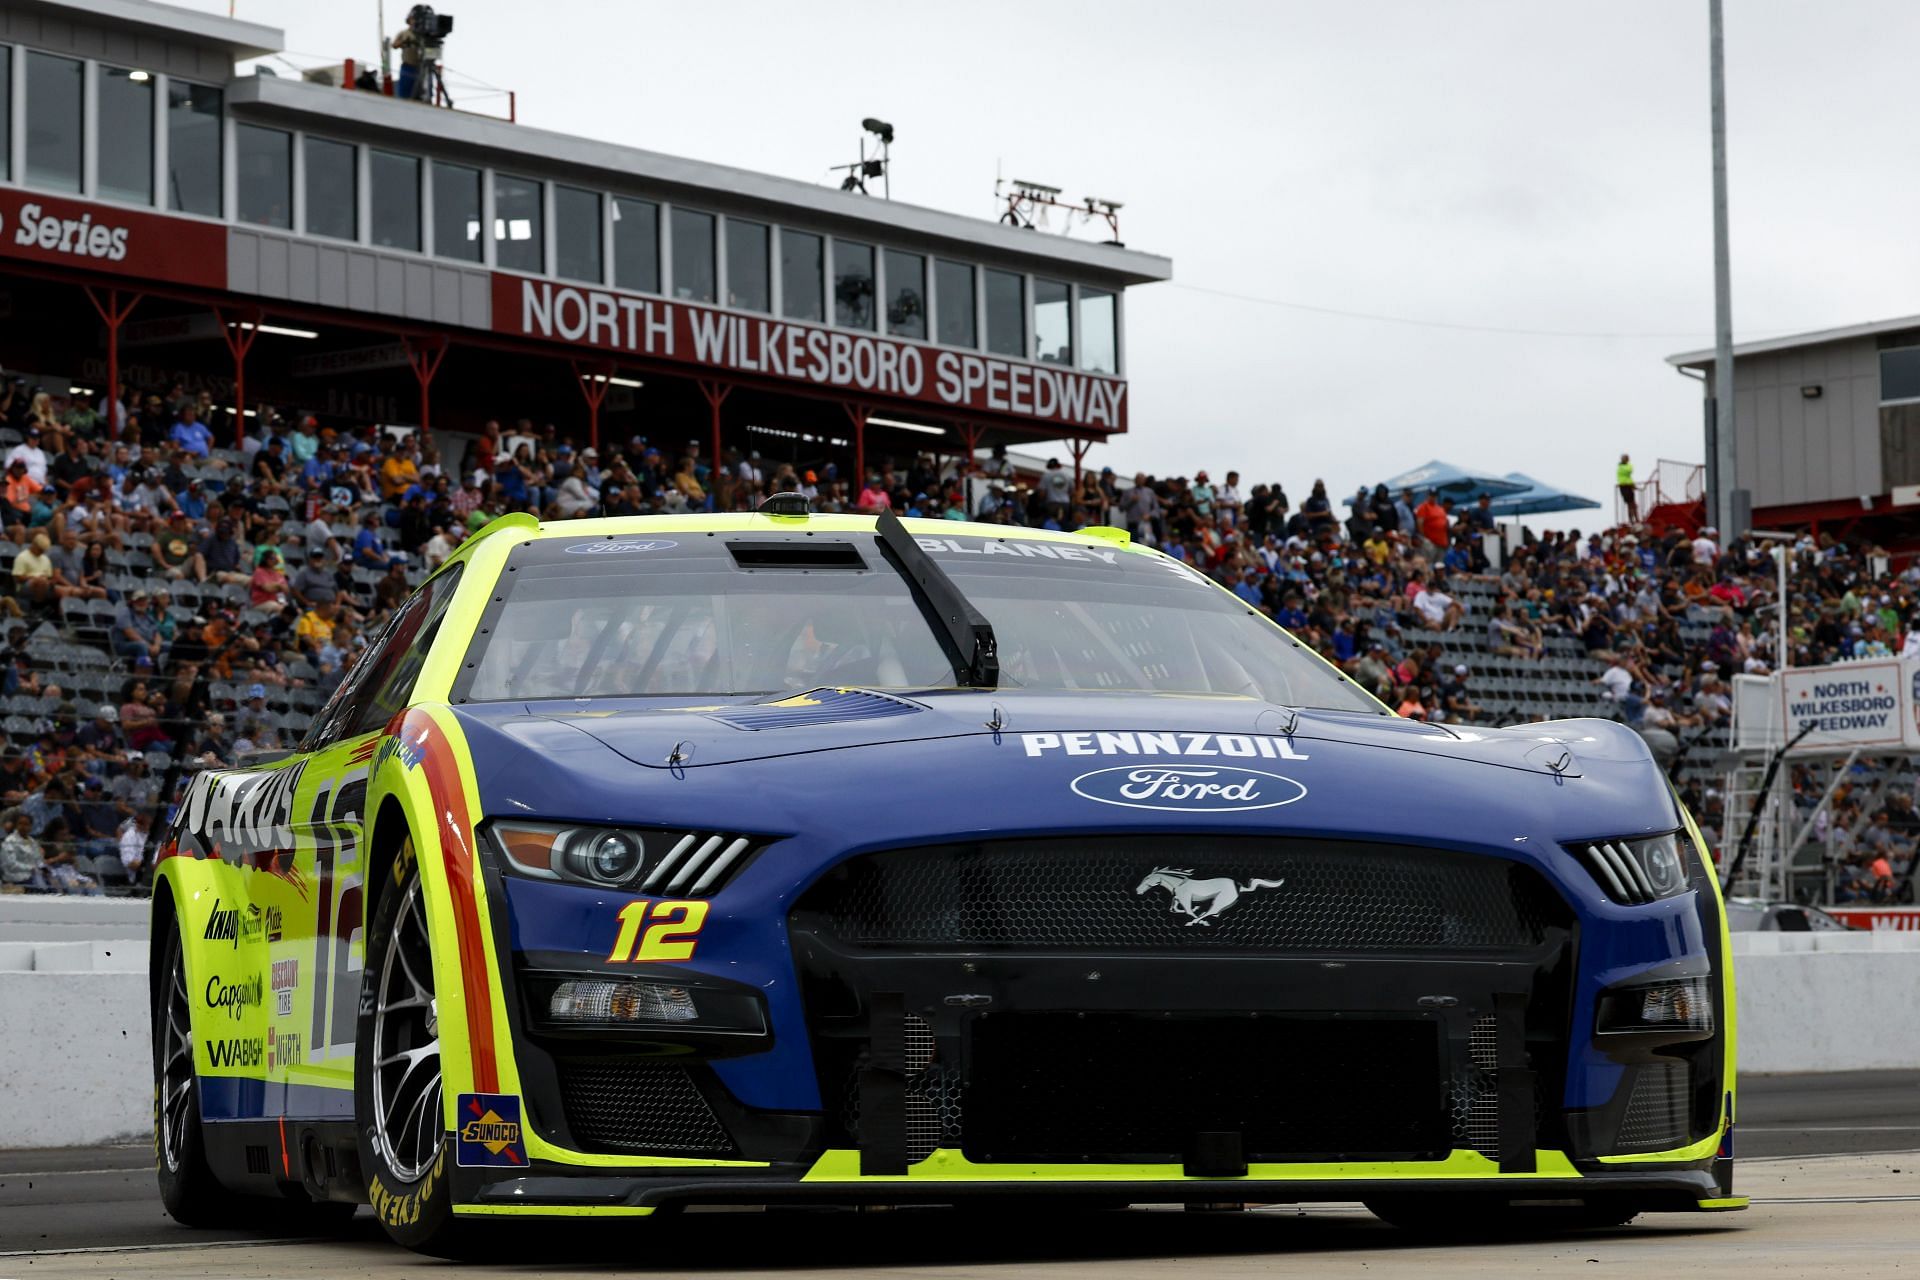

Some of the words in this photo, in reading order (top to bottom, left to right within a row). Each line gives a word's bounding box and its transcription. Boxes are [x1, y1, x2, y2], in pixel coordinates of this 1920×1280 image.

[15, 203, 129, 262] Series
[521, 279, 675, 355] NORTH
[687, 307, 923, 397] WILKESBORO
[935, 350, 1127, 430] SPEEDWAY
[586, 541, 656, 553] Ford
[914, 537, 1118, 565] BLANEY
[1813, 681, 1870, 698] NORTH
[1790, 696, 1896, 717] WILKESBORO
[1799, 713, 1888, 733] SEEDWAY
[1020, 732, 1312, 761] PENNZOIL
[1119, 768, 1261, 801] Ford
[606, 899, 712, 963] 12
[271, 959, 299, 991] DISCOUNT
[278, 992, 292, 1013] TIRE
[205, 1037, 264, 1068] WABASH
[275, 1033, 302, 1066] WÜRTH
[465, 1123, 518, 1142] SUNOCO
